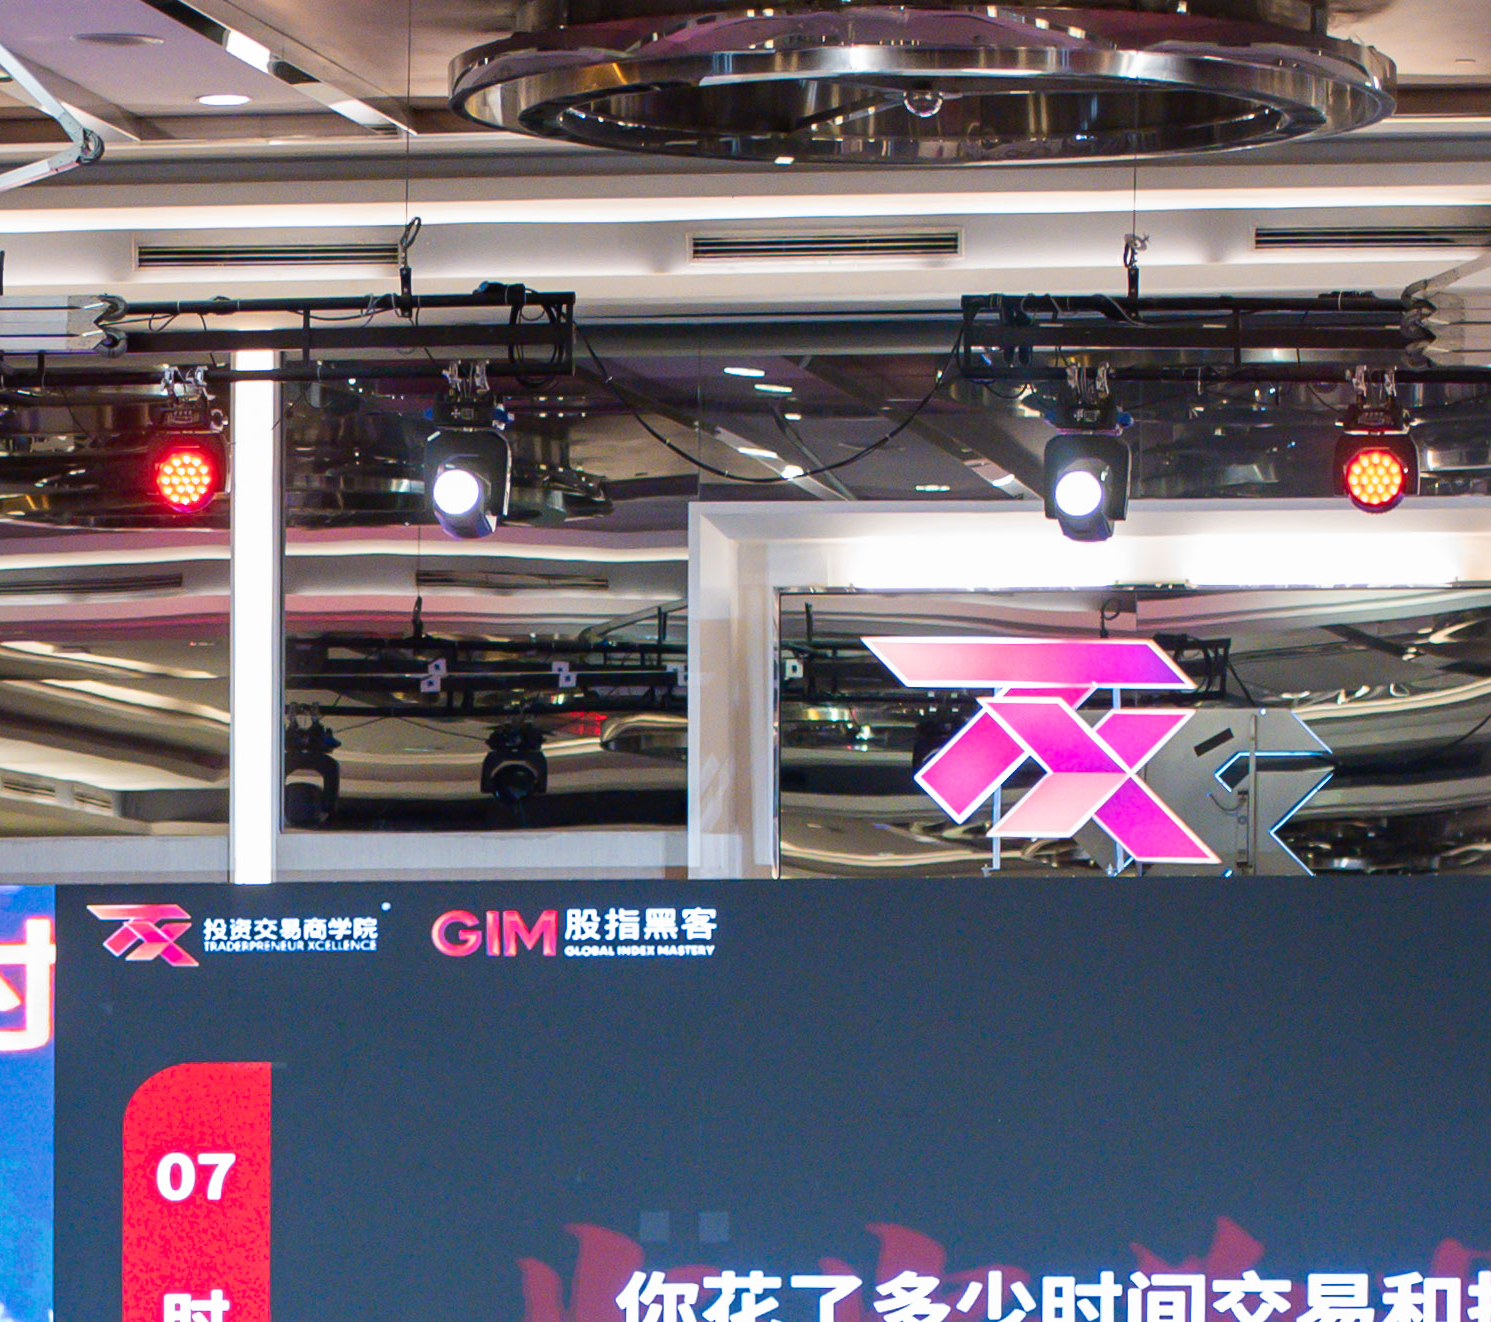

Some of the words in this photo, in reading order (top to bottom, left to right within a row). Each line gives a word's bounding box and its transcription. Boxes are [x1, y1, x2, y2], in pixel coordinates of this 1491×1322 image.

[203, 917, 378, 941] 投资交易商学院
[431, 909, 559, 957] GIM
[564, 907, 718, 941] 股指黑客
[307, 940, 377, 951] XCELLENCE
[564, 945, 615, 956] GLOBAL
[656, 944, 715, 956] MASTERY
[156, 1153, 237, 1201] 07
